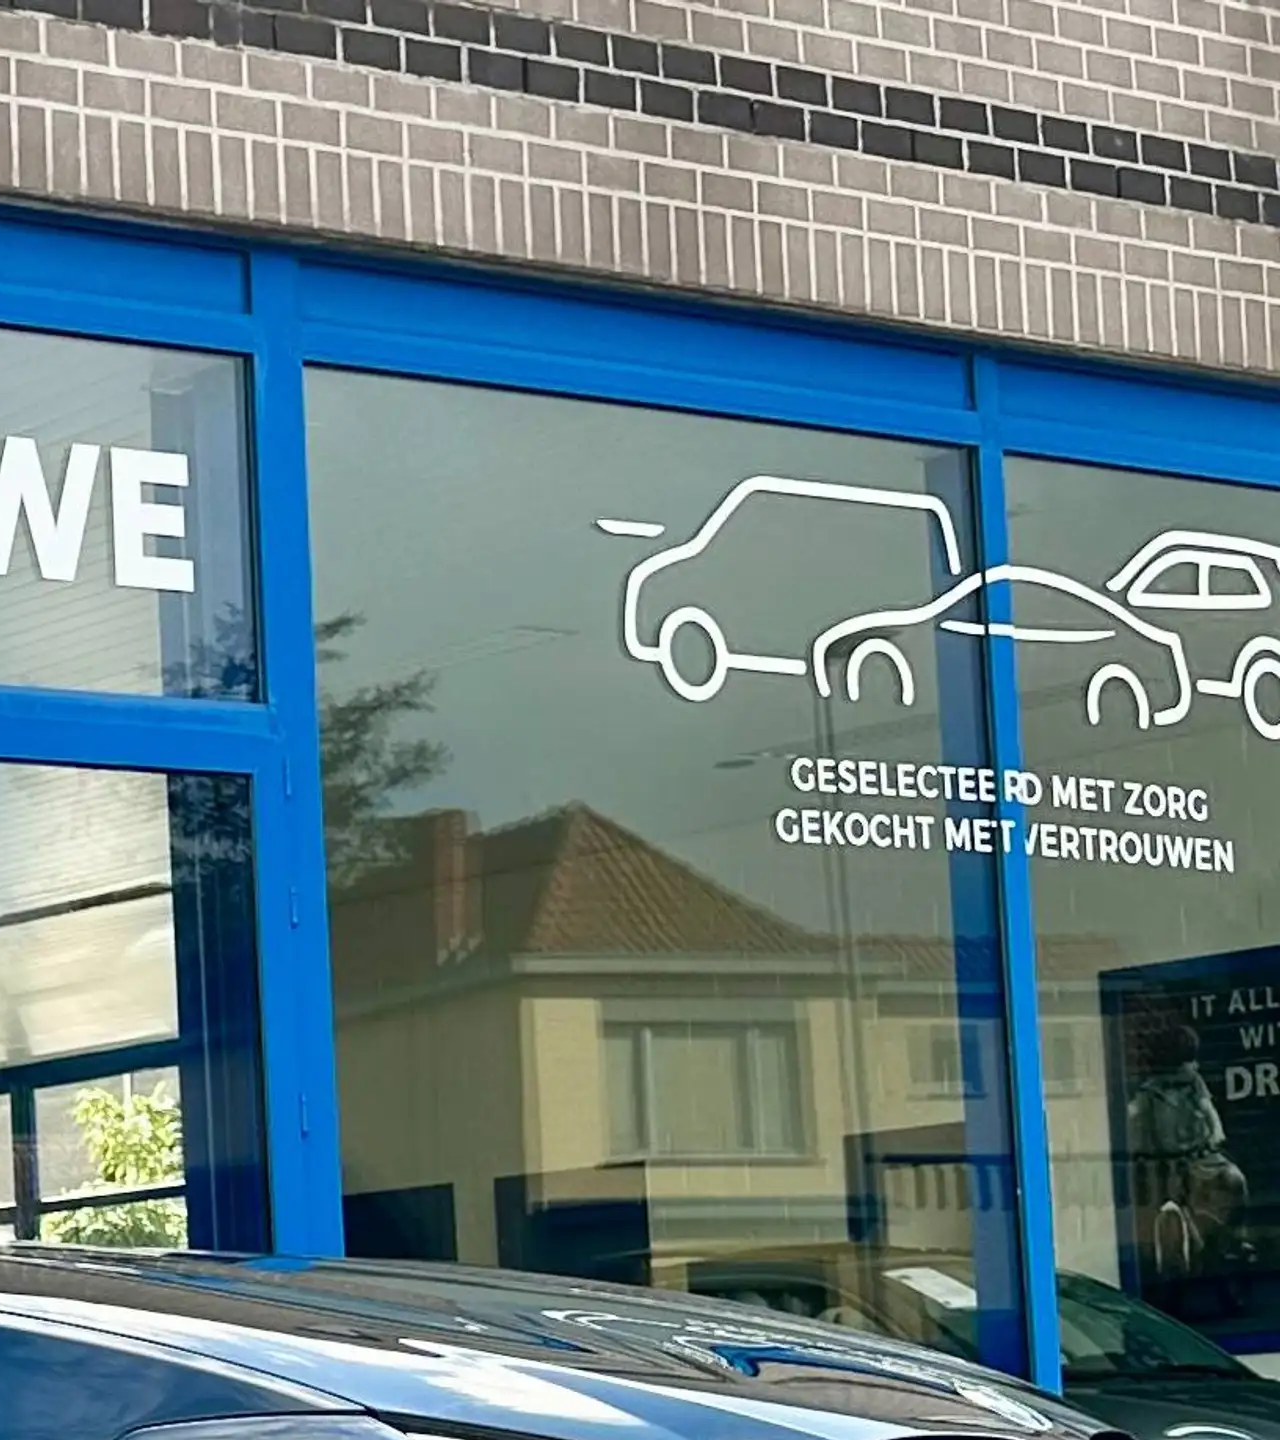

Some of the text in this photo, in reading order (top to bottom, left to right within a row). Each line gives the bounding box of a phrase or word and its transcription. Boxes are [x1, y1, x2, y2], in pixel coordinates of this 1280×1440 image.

[791, 757, 1208, 822] GESELECTEERD MET ZORG
[776, 808, 935, 850] GEKOCHT
[944, 817, 1016, 854] MET
[1191, 986, 1280, 1019] IT ALL
[1239, 1021, 1280, 1050] WI
